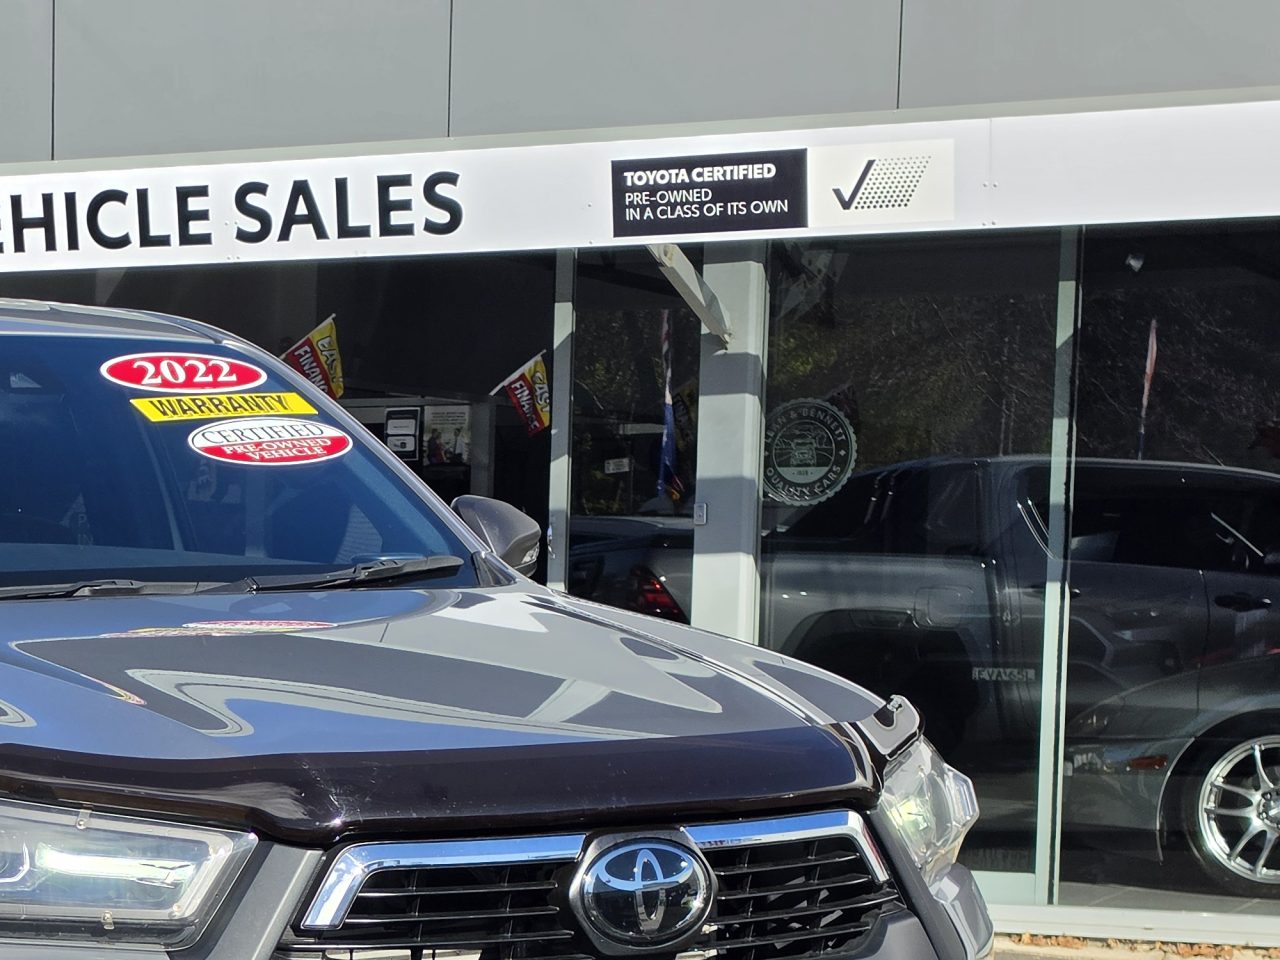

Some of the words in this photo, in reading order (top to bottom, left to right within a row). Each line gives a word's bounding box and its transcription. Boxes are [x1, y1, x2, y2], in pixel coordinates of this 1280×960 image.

[624, 169, 690, 187] TOYOTA
[692, 163, 776, 182] CERTIFIED
[232, 171, 463, 243] SALES
[625, 188, 712, 205] PRE-OWNED
[625, 207, 640, 220] IN
[643, 206, 654, 220] A
[656, 204, 700, 219] CLASS
[703, 203, 724, 217] OF
[727, 201, 748, 215] ITS
[750, 199, 788, 214] OWN
[133, 359, 237, 386] 2022
[294, 345, 329, 393] FINANC
[149, 395, 288, 417] WARRANTY
[202, 422, 323, 445] CERTIFIED
[802, 408, 847, 441] BENNETT
[221, 437, 331, 455] PRE-OWNED
[247, 445, 327, 461] VEHICLE
[815, 465, 841, 494] CARS
